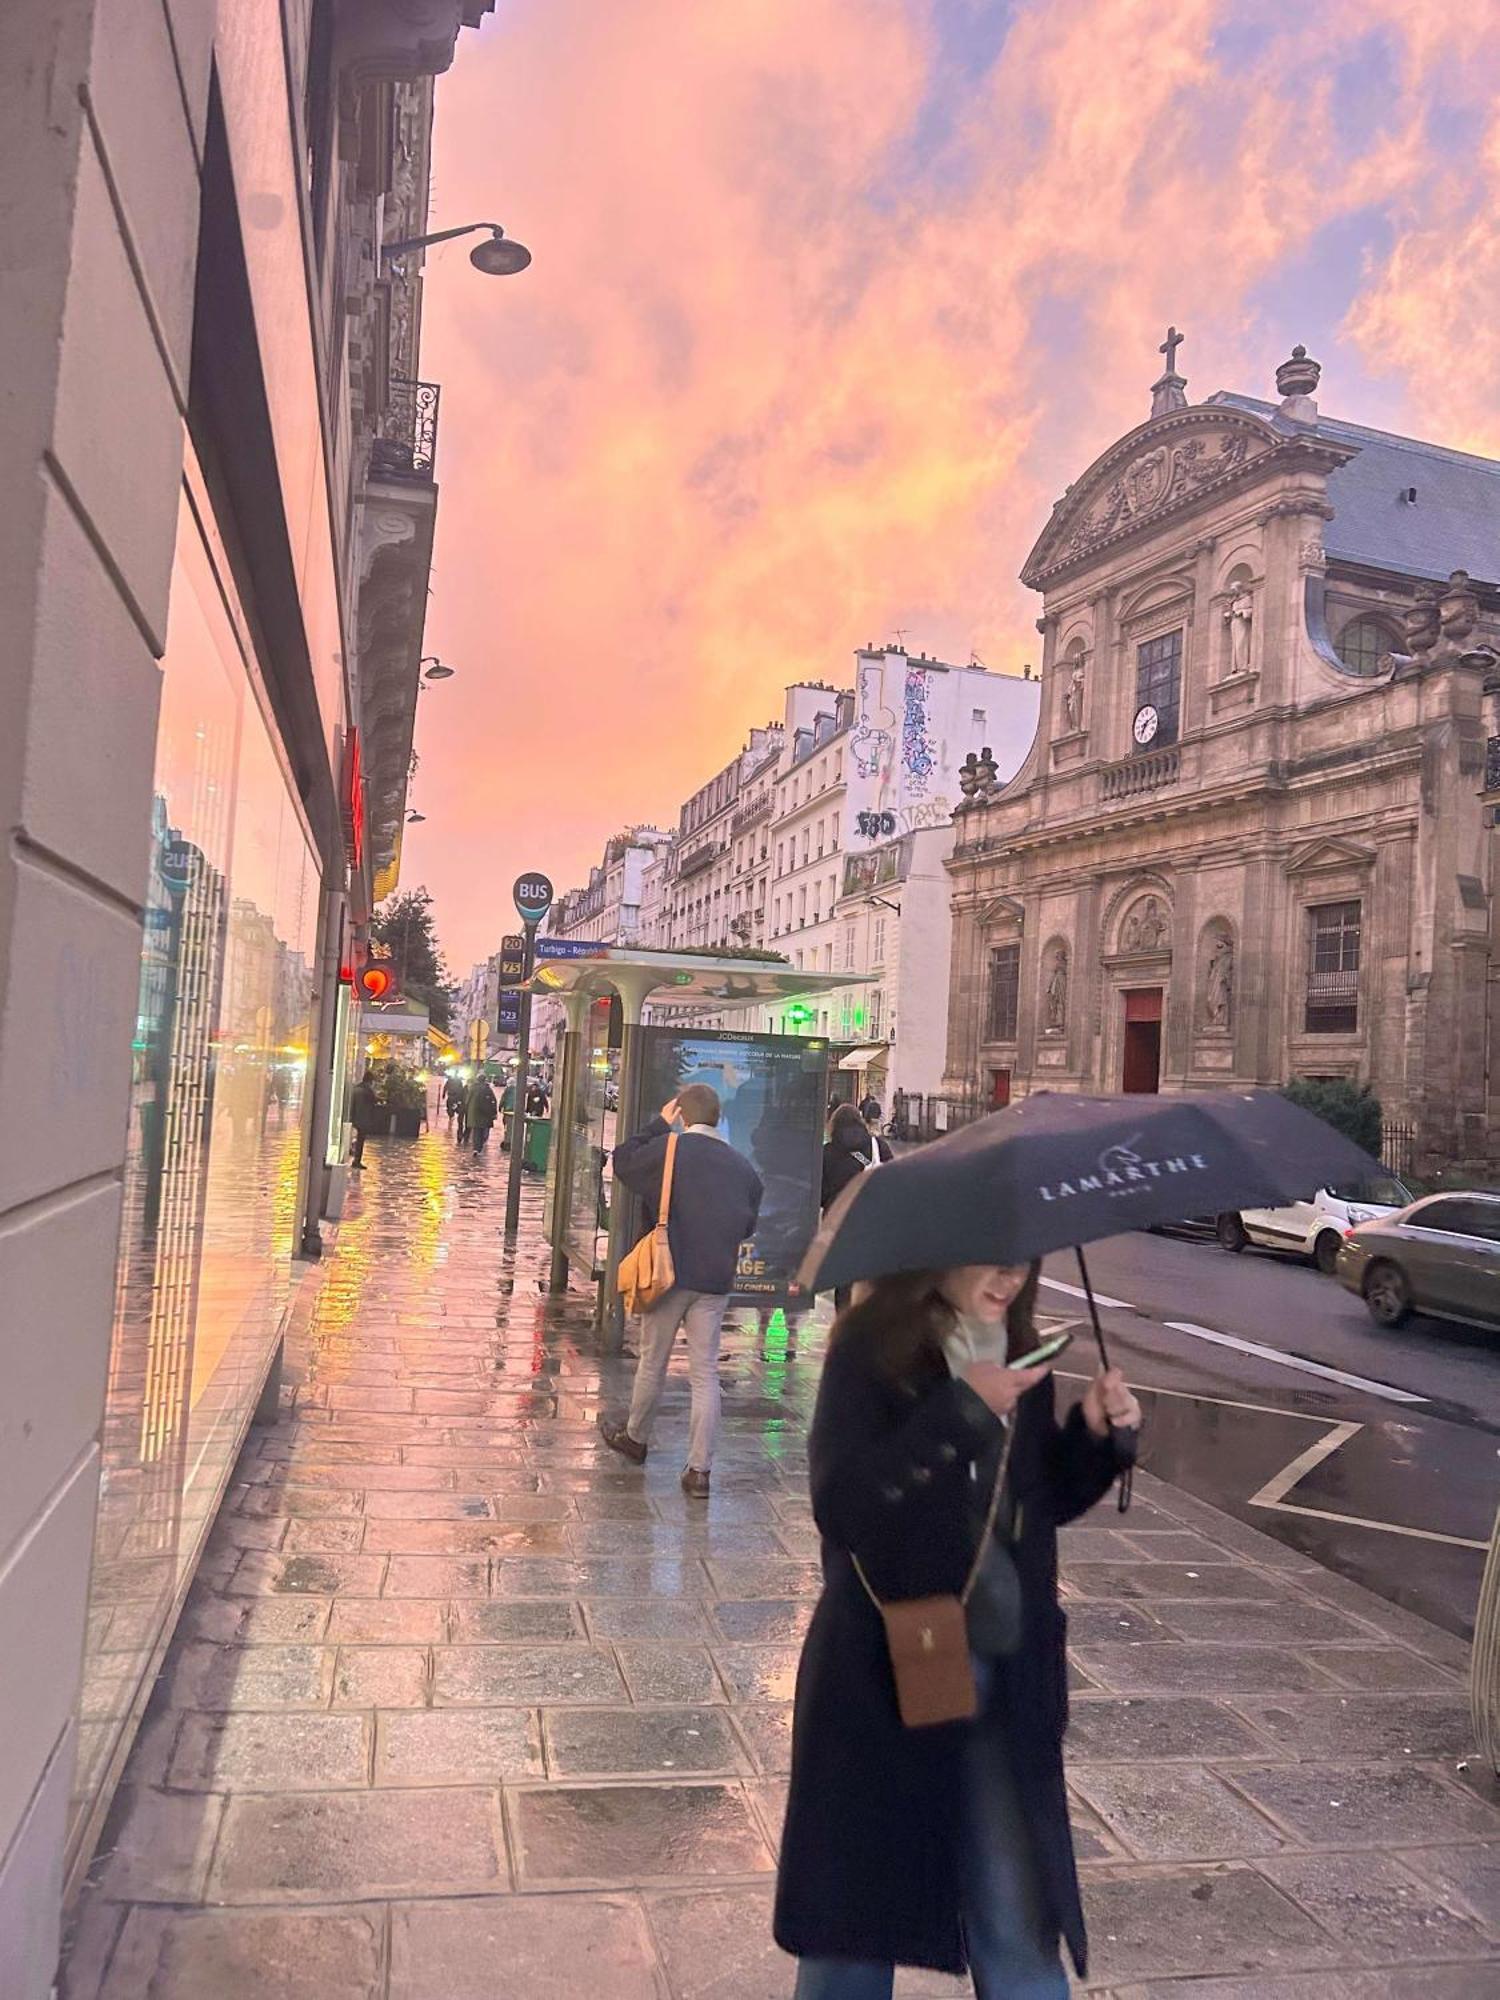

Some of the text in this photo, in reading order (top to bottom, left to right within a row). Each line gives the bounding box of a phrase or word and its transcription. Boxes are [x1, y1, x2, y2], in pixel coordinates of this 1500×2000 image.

[519, 883, 548, 900] BUS
[506, 939, 520, 949] 20
[540, 944, 566, 956] Turbigo
[505, 962, 519, 973] 75
[717, 1032, 755, 1042] JCDecaux
[1038, 1154, 1208, 1202] LAMARTHE
